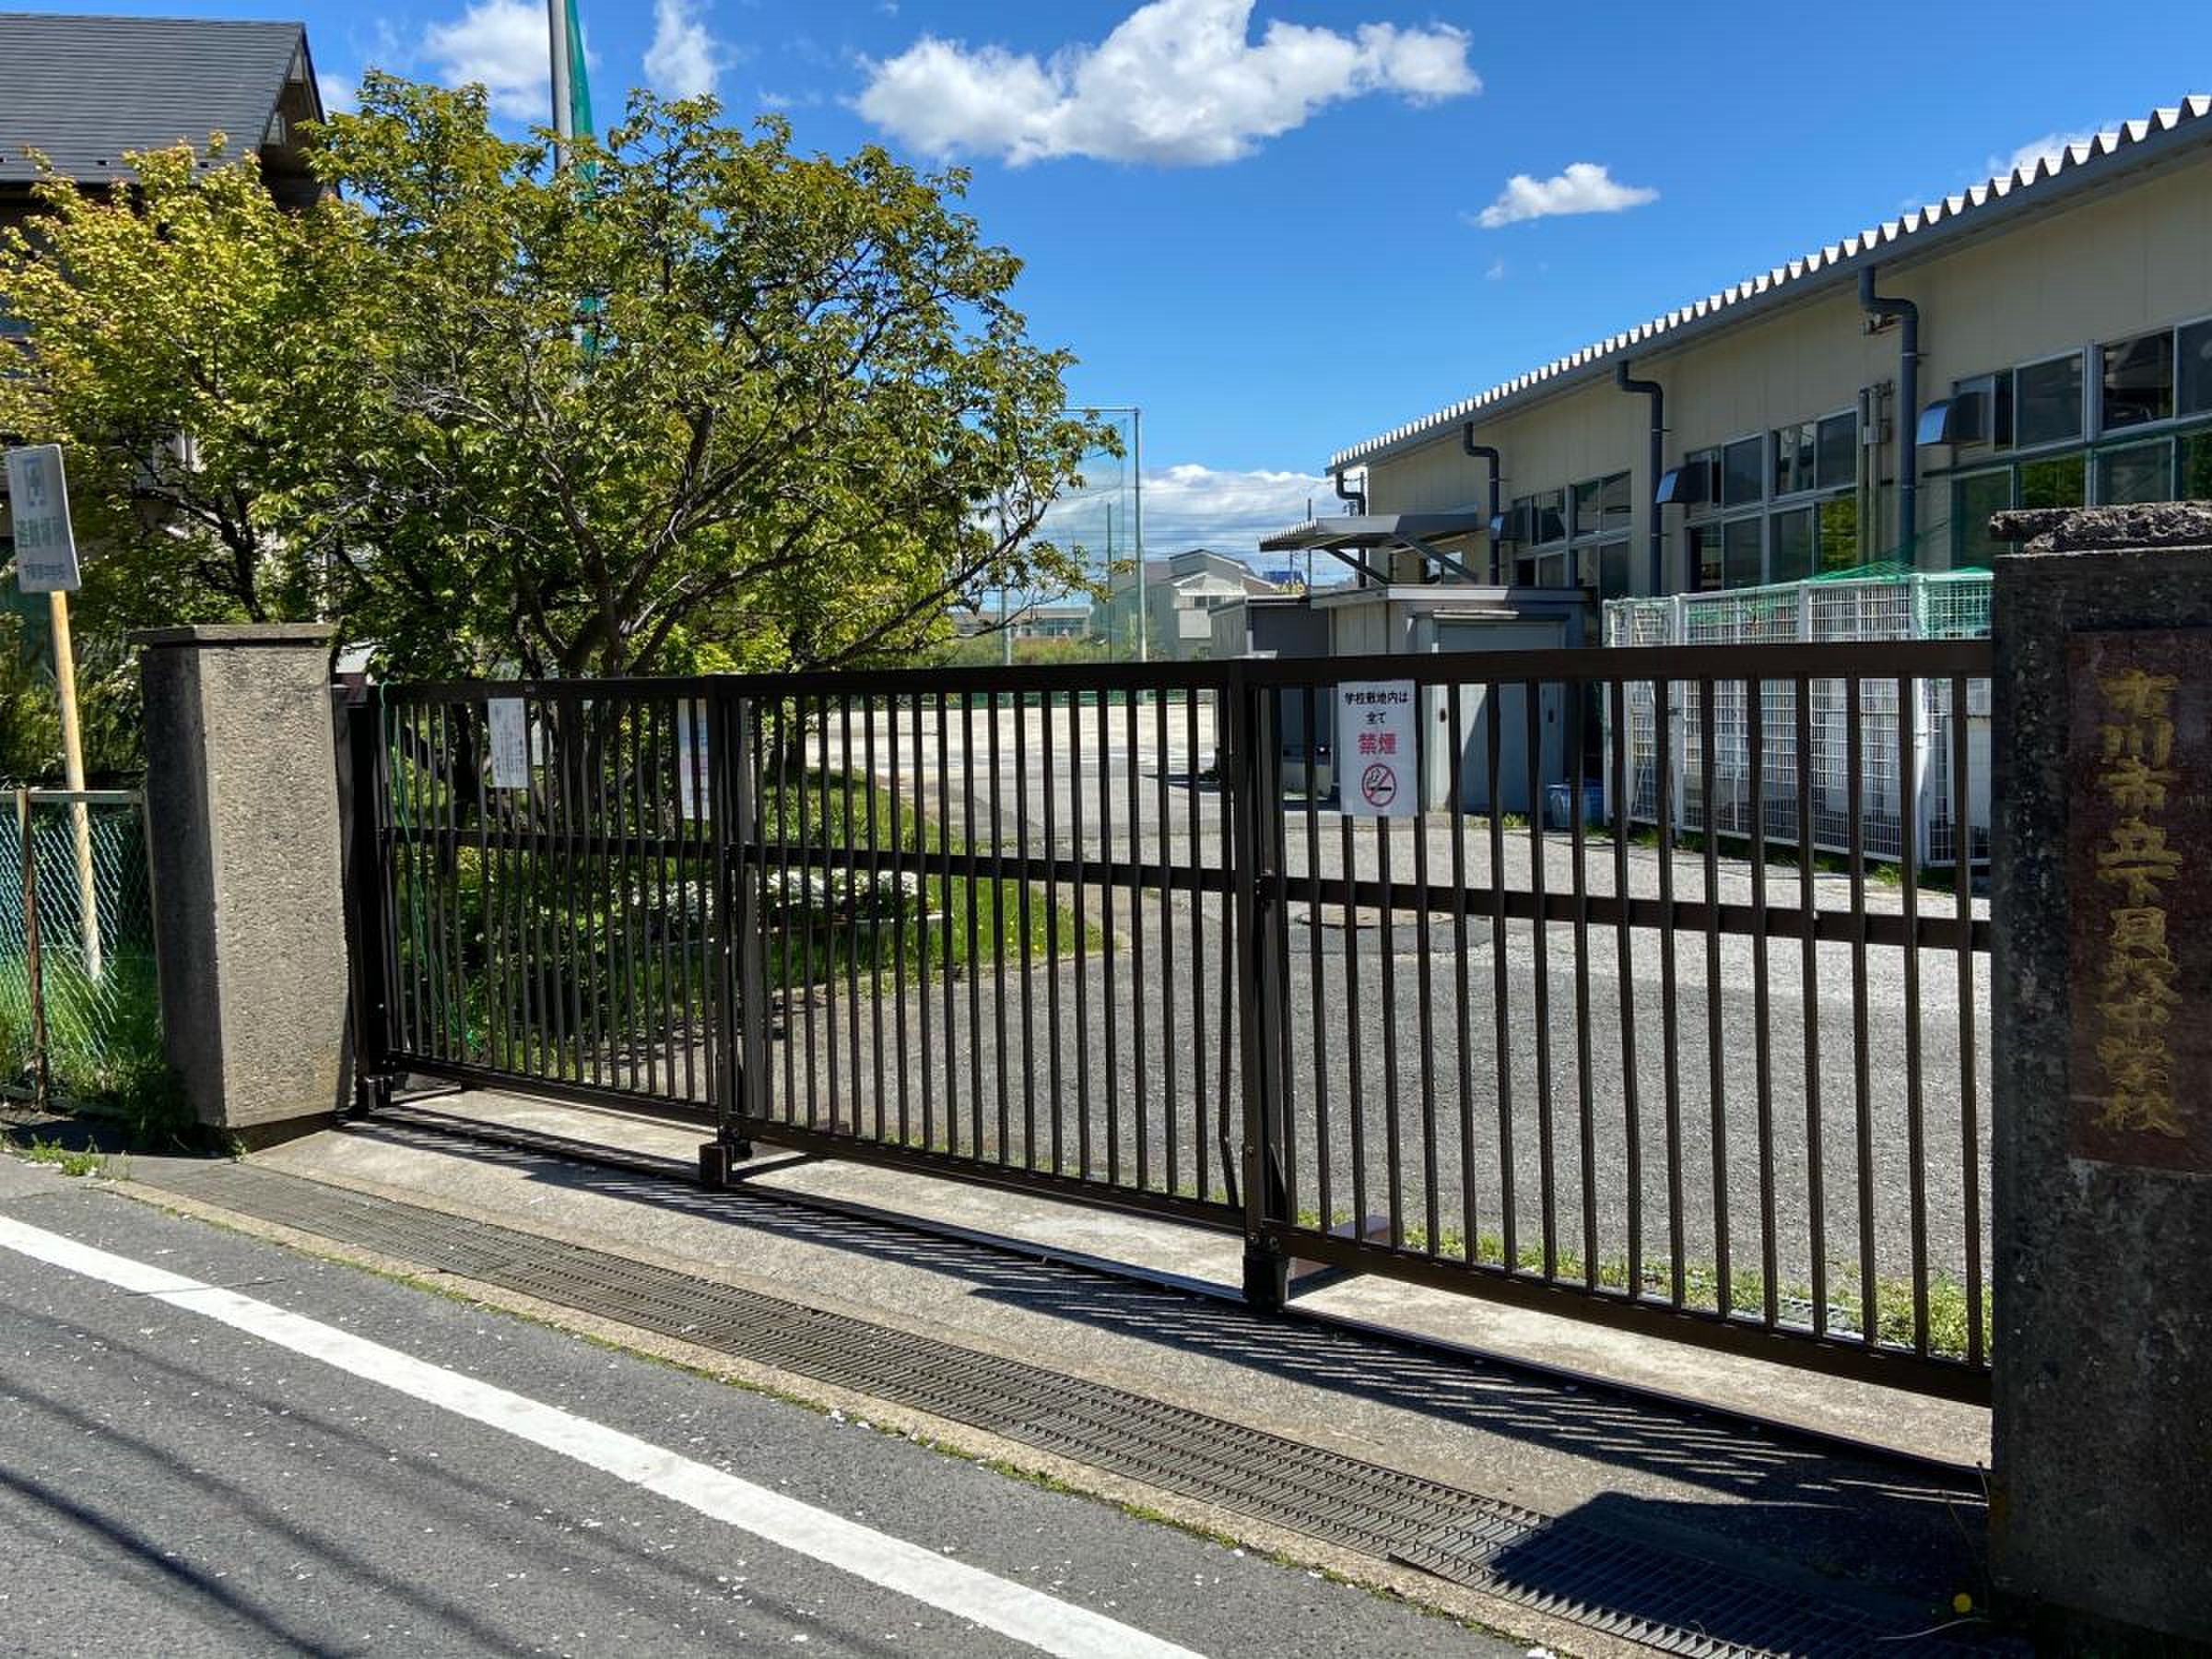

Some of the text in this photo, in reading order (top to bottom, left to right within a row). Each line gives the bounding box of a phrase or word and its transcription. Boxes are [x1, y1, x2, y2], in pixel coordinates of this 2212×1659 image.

[1345, 691, 1409, 705] 学校敷地内は
[1365, 711, 1387, 724] 全て
[1358, 732, 1397, 755] 禁煙
